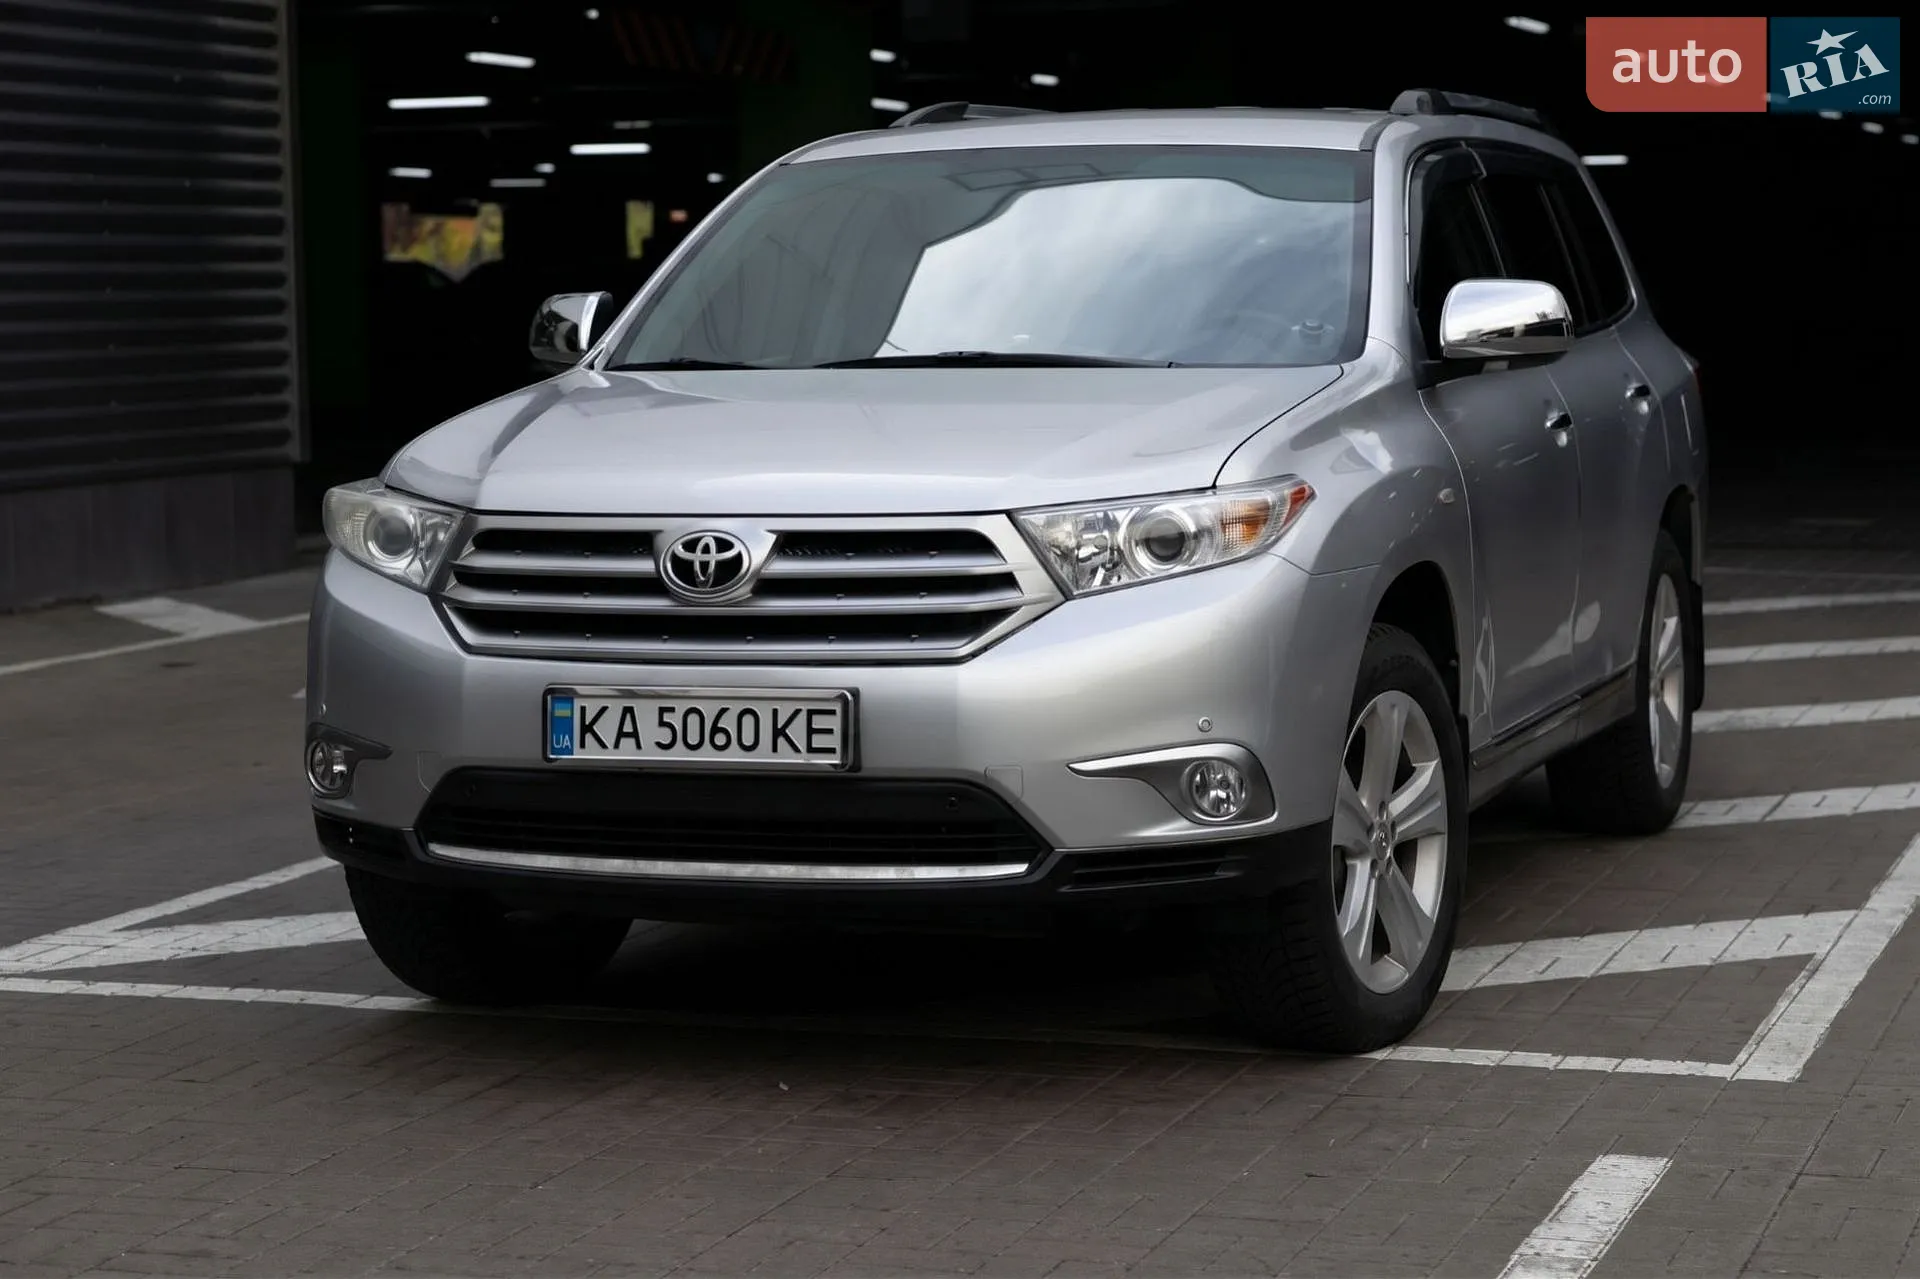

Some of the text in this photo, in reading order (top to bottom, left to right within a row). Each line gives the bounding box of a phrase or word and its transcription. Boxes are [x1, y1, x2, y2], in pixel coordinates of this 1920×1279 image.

[552, 735, 572, 749] UA
[579, 705, 837, 754] KA 5060 KE
